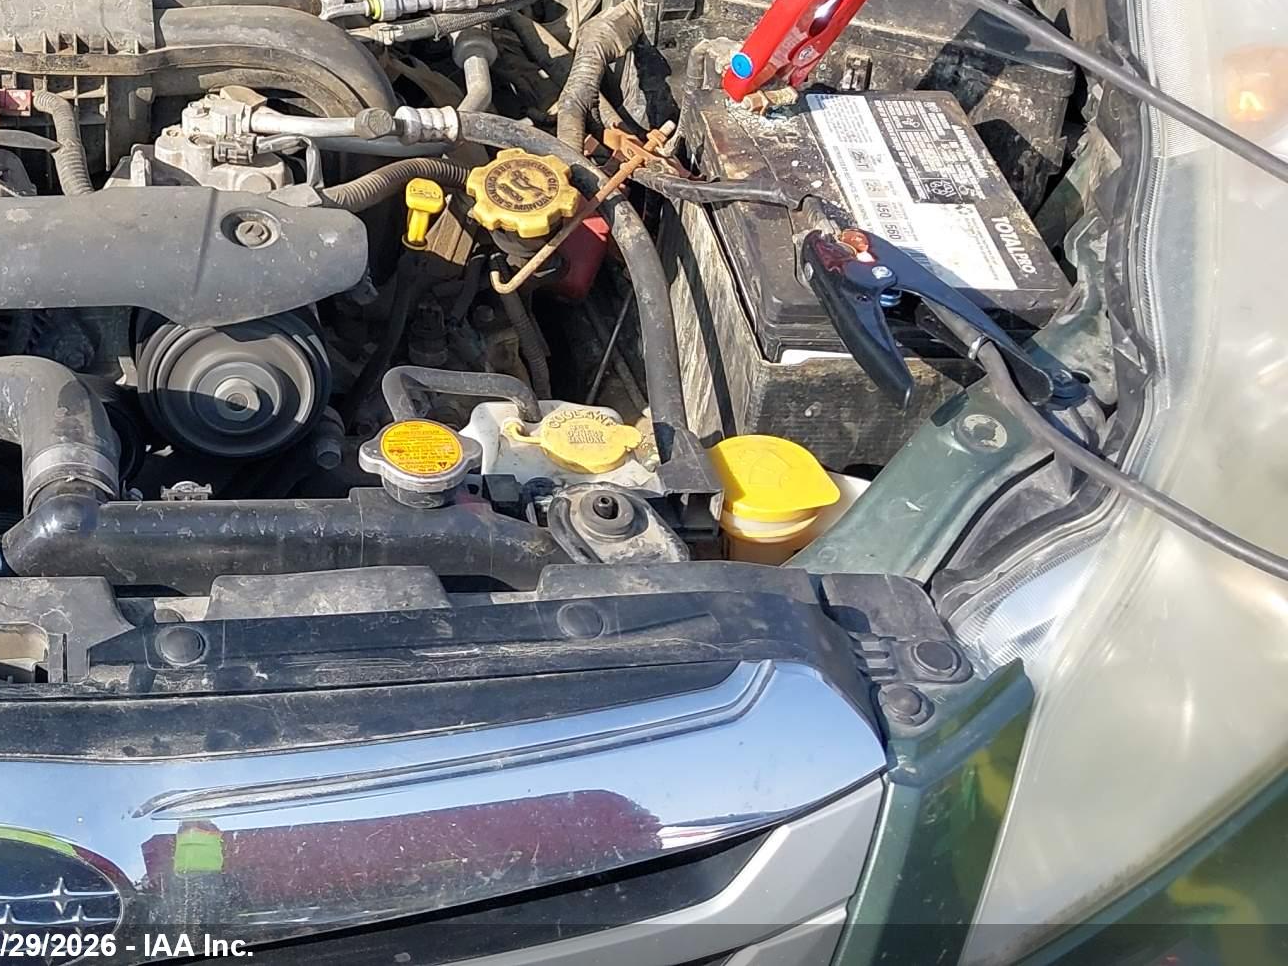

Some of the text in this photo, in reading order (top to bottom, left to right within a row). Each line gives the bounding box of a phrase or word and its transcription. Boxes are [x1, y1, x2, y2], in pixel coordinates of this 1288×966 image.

[513, 194, 553, 212] MANUAL
[876, 202, 893, 218] 450
[884, 223, 903, 240] 560
[547, 408, 616, 429] COOLANT
